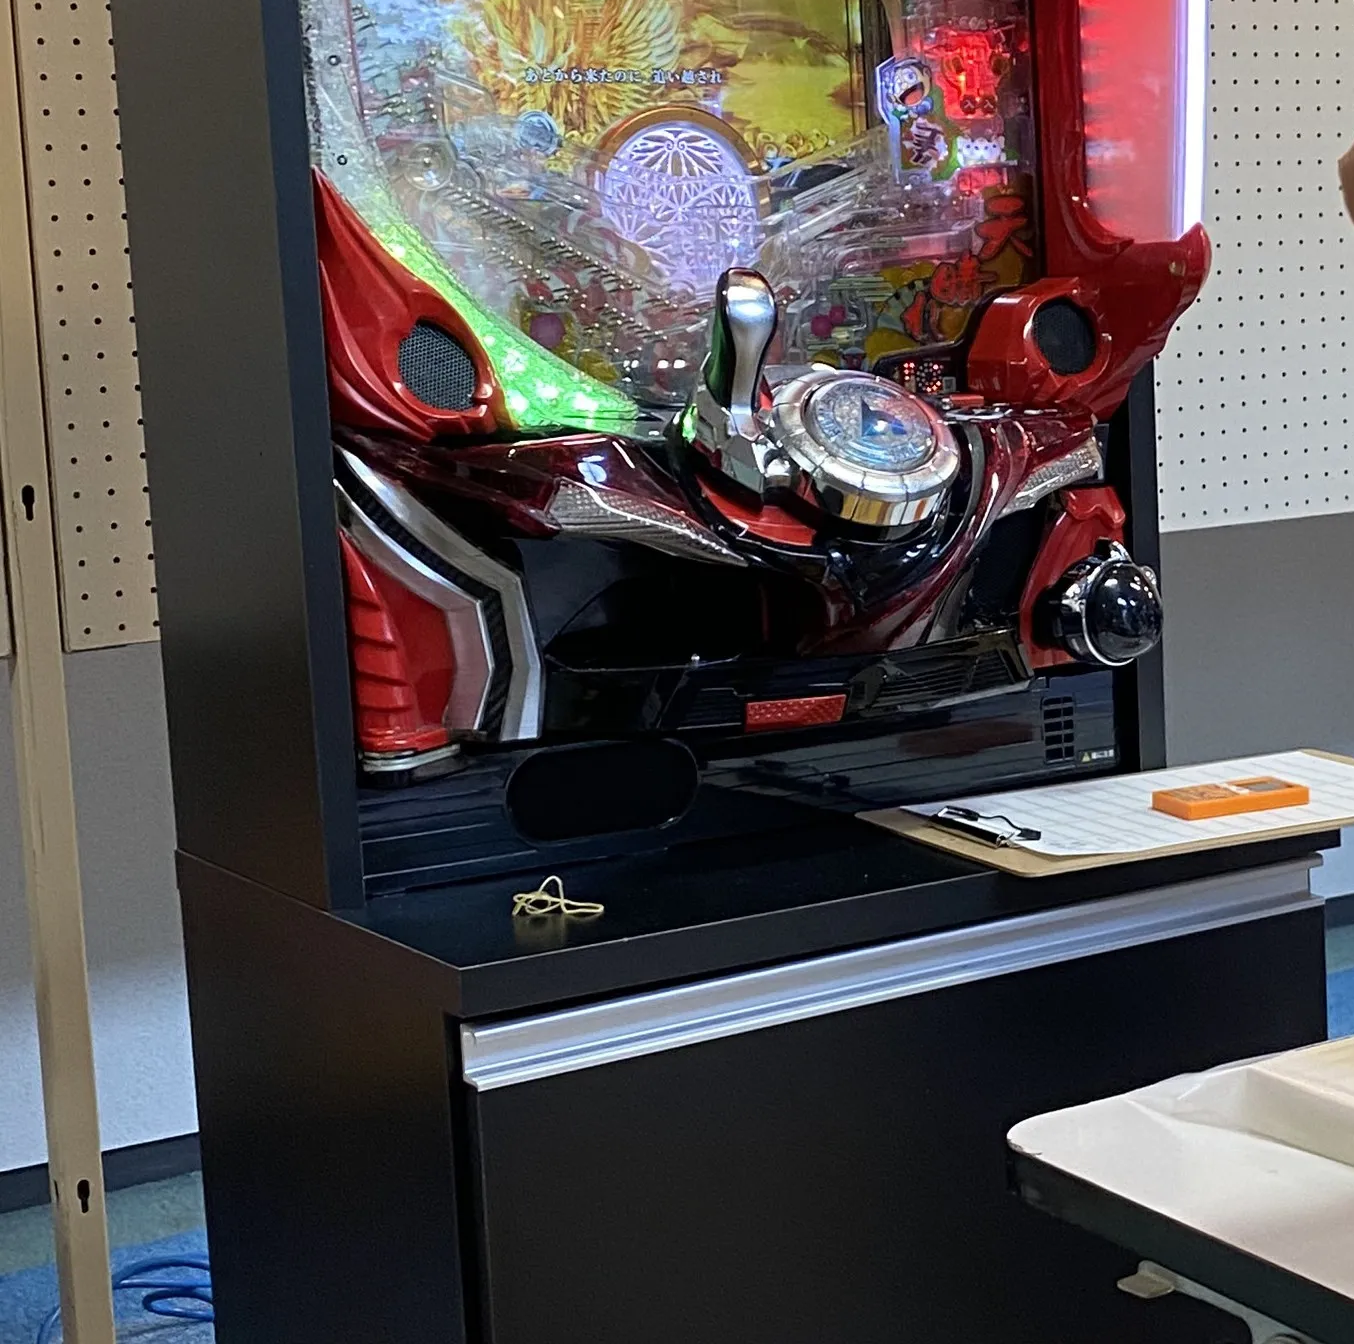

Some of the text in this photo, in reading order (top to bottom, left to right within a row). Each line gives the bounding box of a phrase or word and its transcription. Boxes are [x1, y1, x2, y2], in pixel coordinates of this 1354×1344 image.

[524, 67, 724, 85] あとから来たのに 追い越され
